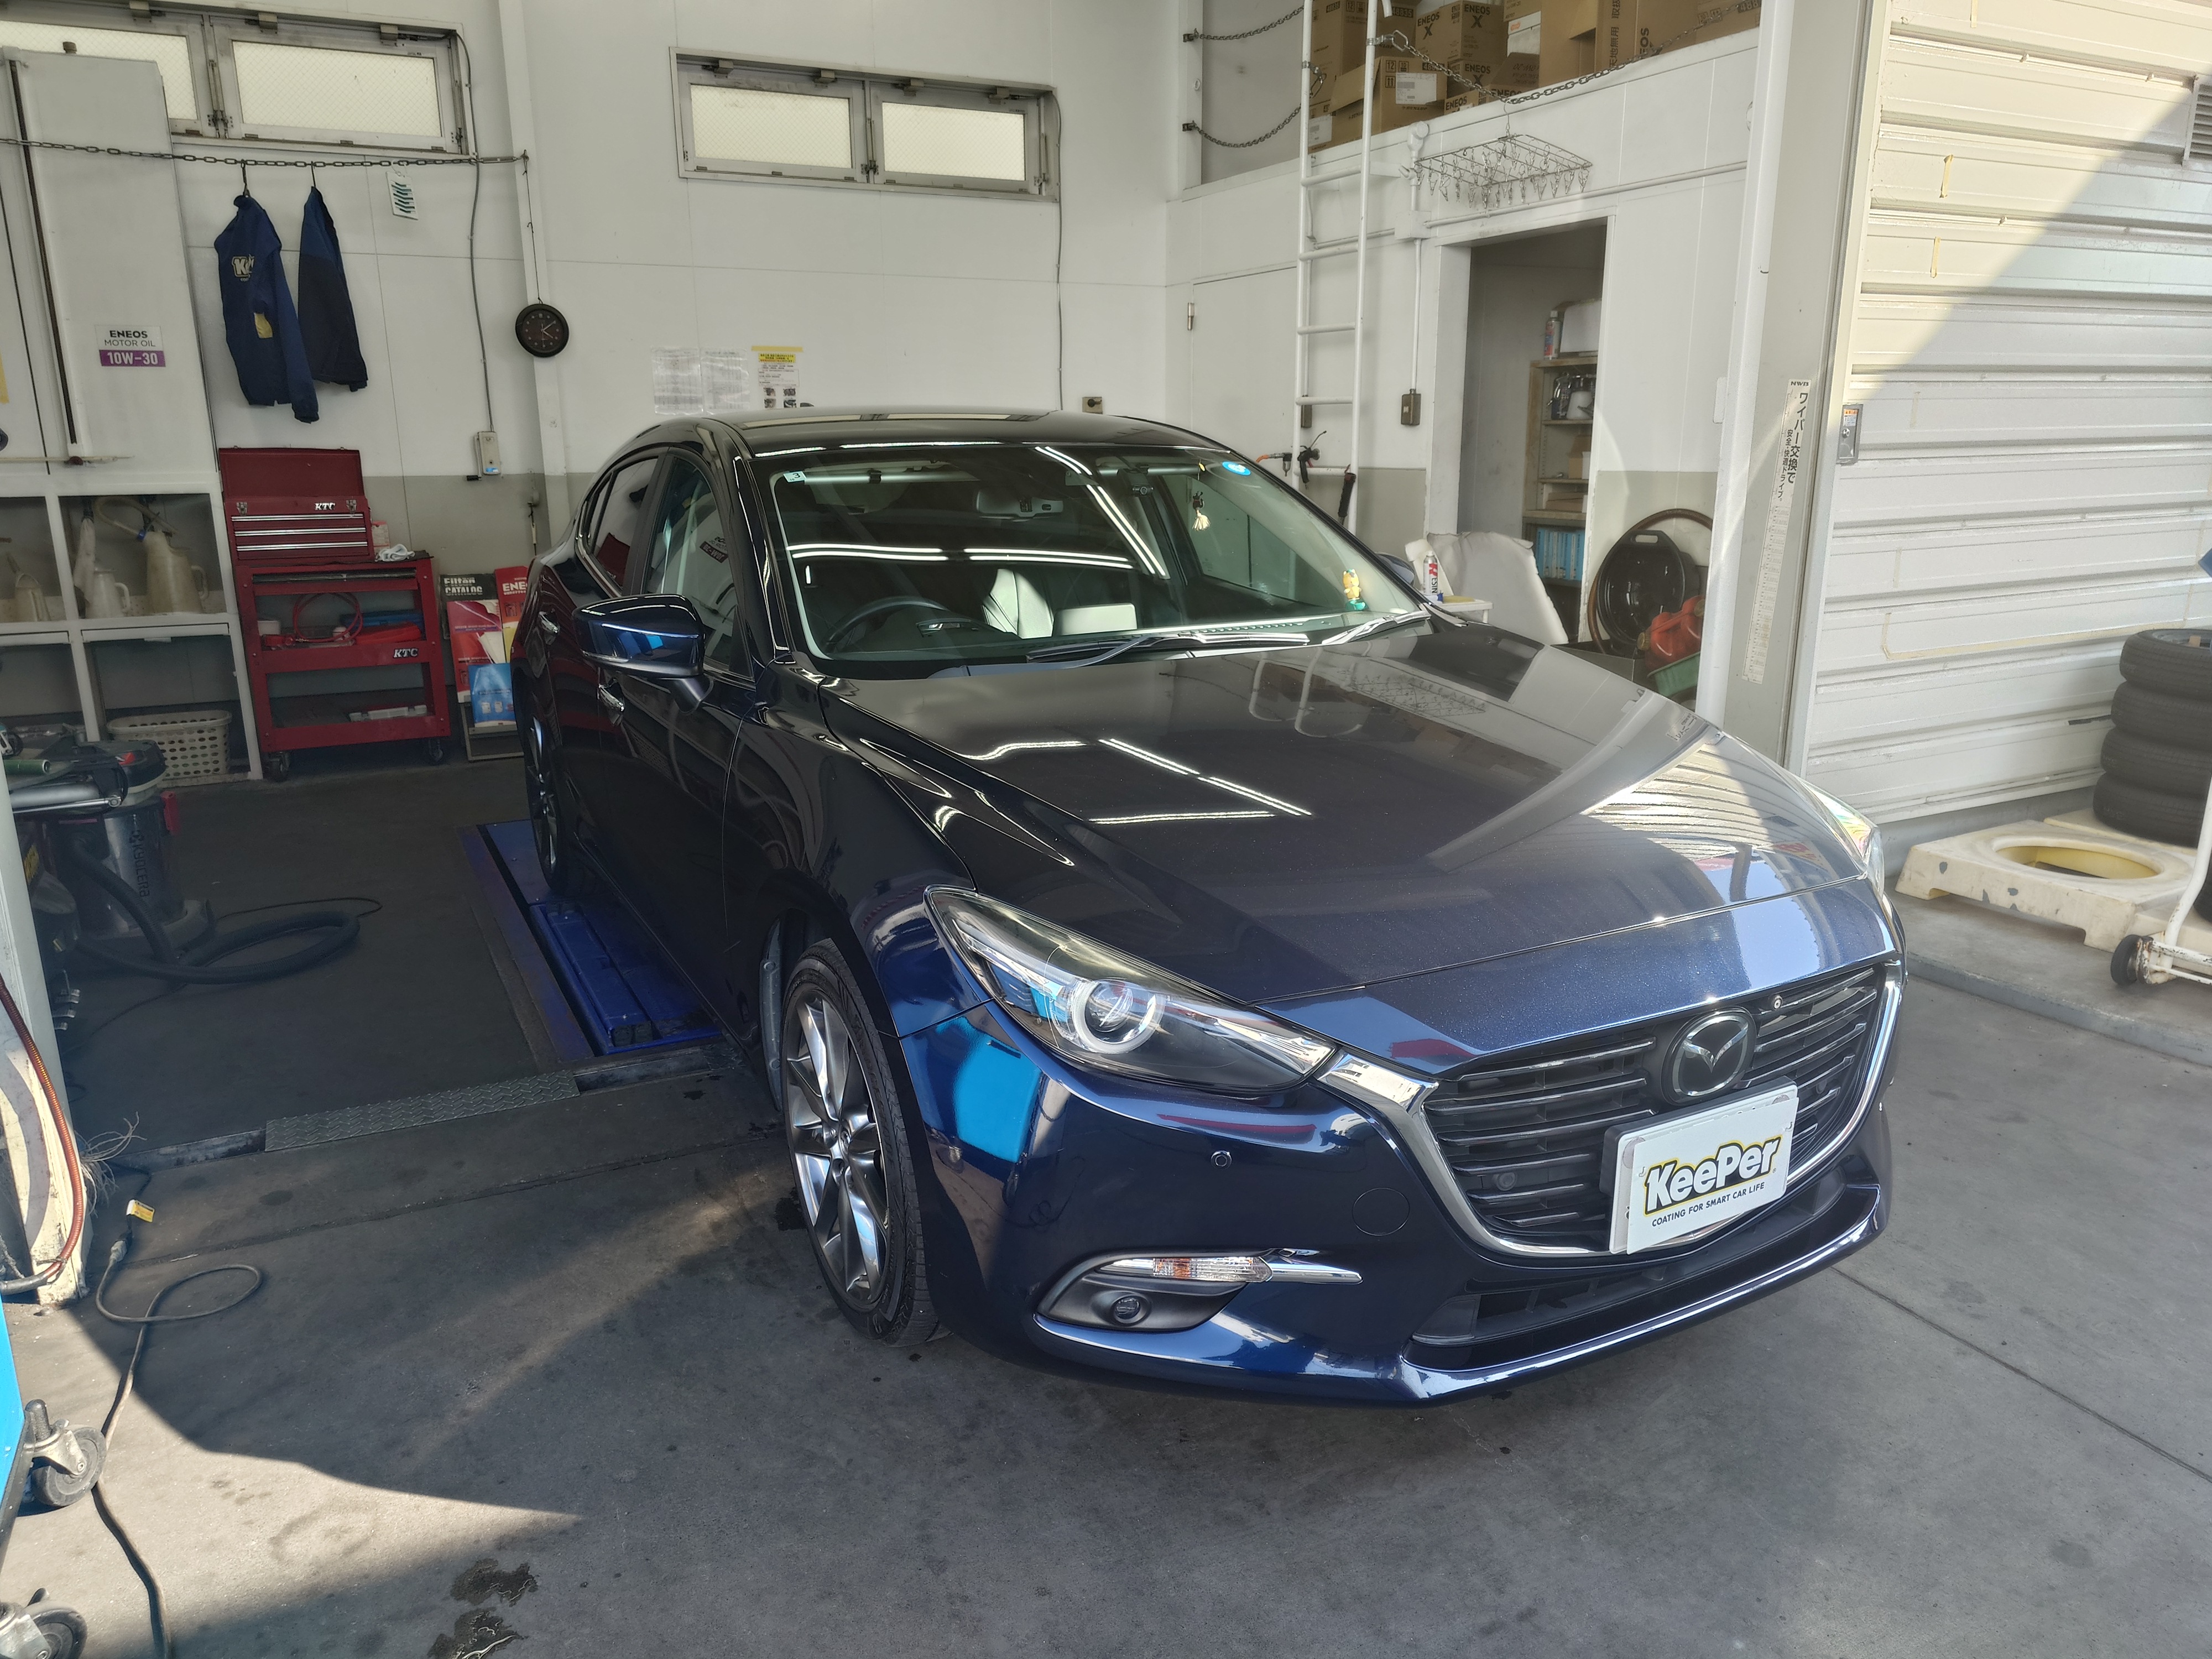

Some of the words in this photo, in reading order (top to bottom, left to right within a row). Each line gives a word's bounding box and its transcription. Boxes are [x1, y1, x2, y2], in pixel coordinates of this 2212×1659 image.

[1464, 4, 1490, 15] ENEOS
[1417, 12, 1440, 27] ENEOS
[1471, 15, 1483, 28] X
[1387, 61, 1395, 70] 12
[1465, 64, 1491, 74] ENEOS
[1446, 96, 1467, 111] ENEOS
[110, 330, 148, 338] ENEOS
[107, 352, 158, 365] 10W-30
[1787, 392, 1808, 484] ワイパー交換で
[315, 502, 336, 510] KTC
[502, 581, 528, 592] ENE
[393, 648, 418, 658] KTC
[132, 844, 150, 897] KYOCERA
[1645, 1136, 1781, 1215] KeePer
[1652, 1209, 1686, 1227] COATING
[1688, 1203, 1703, 1215] FOR
[1705, 1194, 1731, 1208] SMART
[1733, 1190, 1747, 1199] CAR
[1749, 1182, 1765, 1193] LIFE
